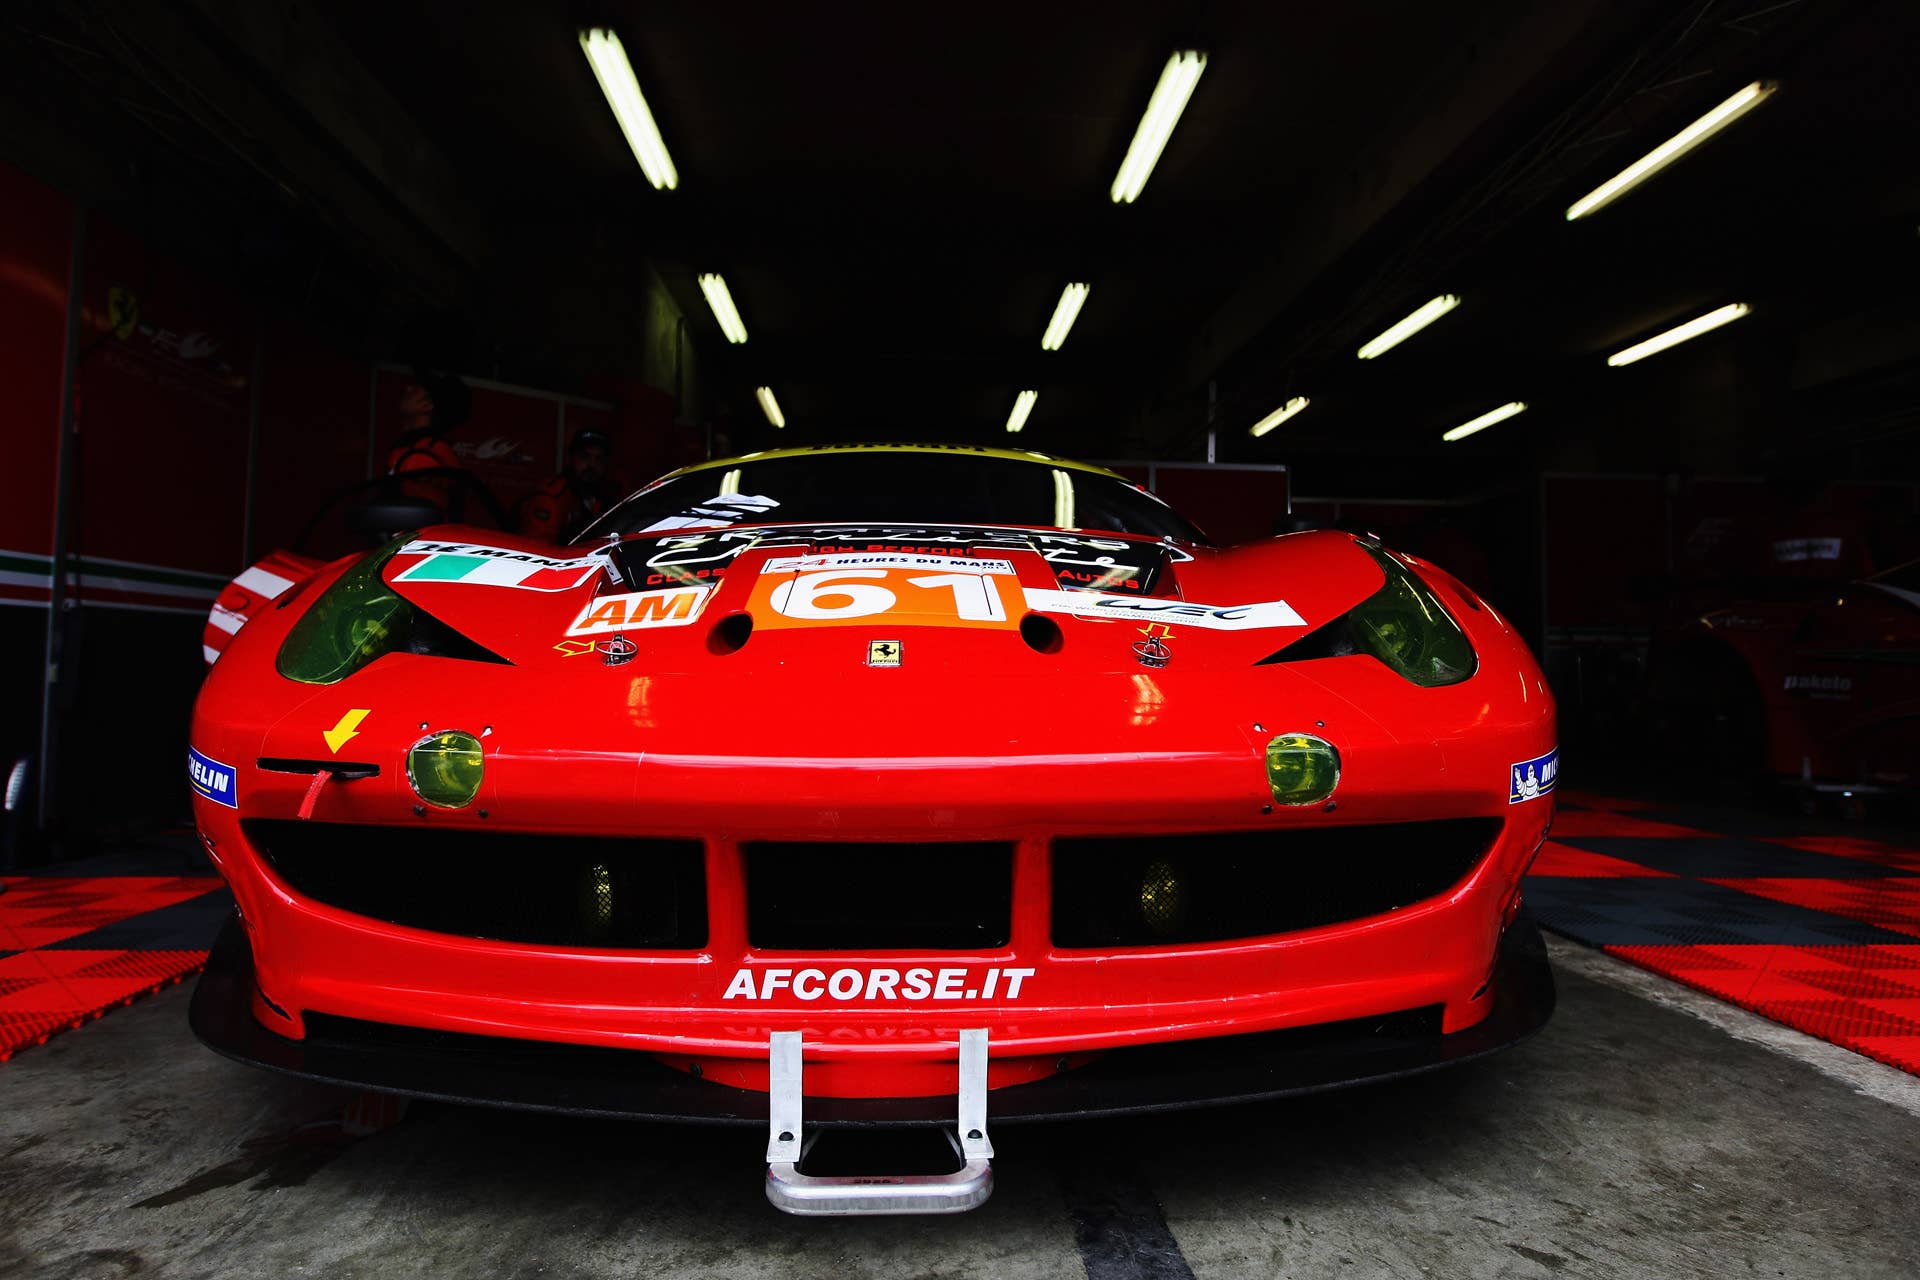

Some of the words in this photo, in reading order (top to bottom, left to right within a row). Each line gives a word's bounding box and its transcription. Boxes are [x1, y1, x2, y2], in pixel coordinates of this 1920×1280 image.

[469, 548, 582, 568] MANS
[836, 556, 909, 565] HEURES
[916, 557, 942, 565] DU
[949, 559, 1006, 568] MANS
[1057, 568, 1139, 590] AUTOS
[770, 569, 1007, 621] 61
[575, 593, 699, 629] AM
[722, 967, 1036, 1001] AFCORSE.IT
